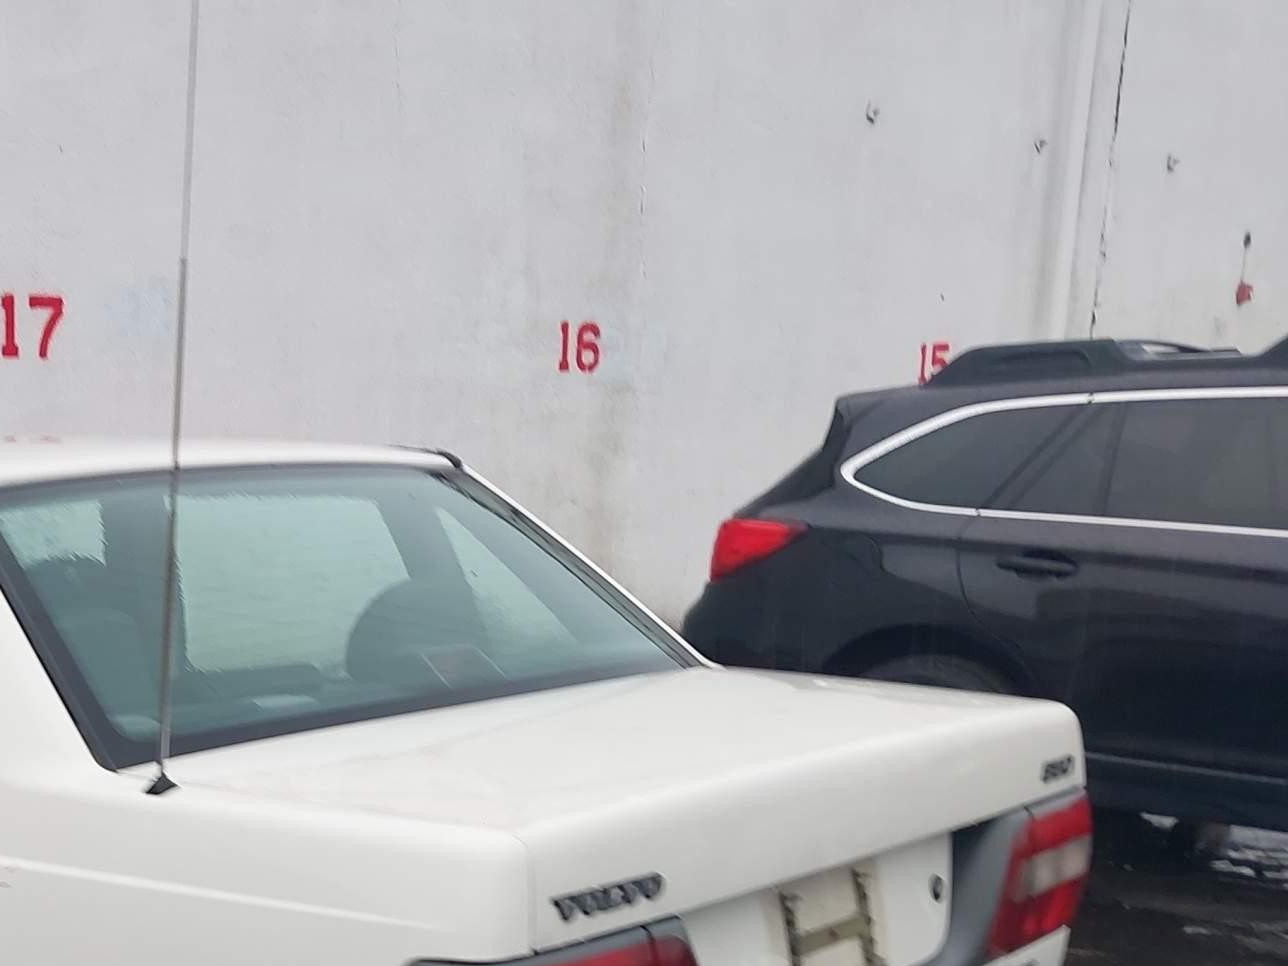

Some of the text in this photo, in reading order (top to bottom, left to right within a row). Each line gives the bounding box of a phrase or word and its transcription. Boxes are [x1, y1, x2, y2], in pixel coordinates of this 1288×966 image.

[0, 294, 64, 359] 17
[558, 321, 600, 373] 16
[551, 873, 663, 921] VOLVO
